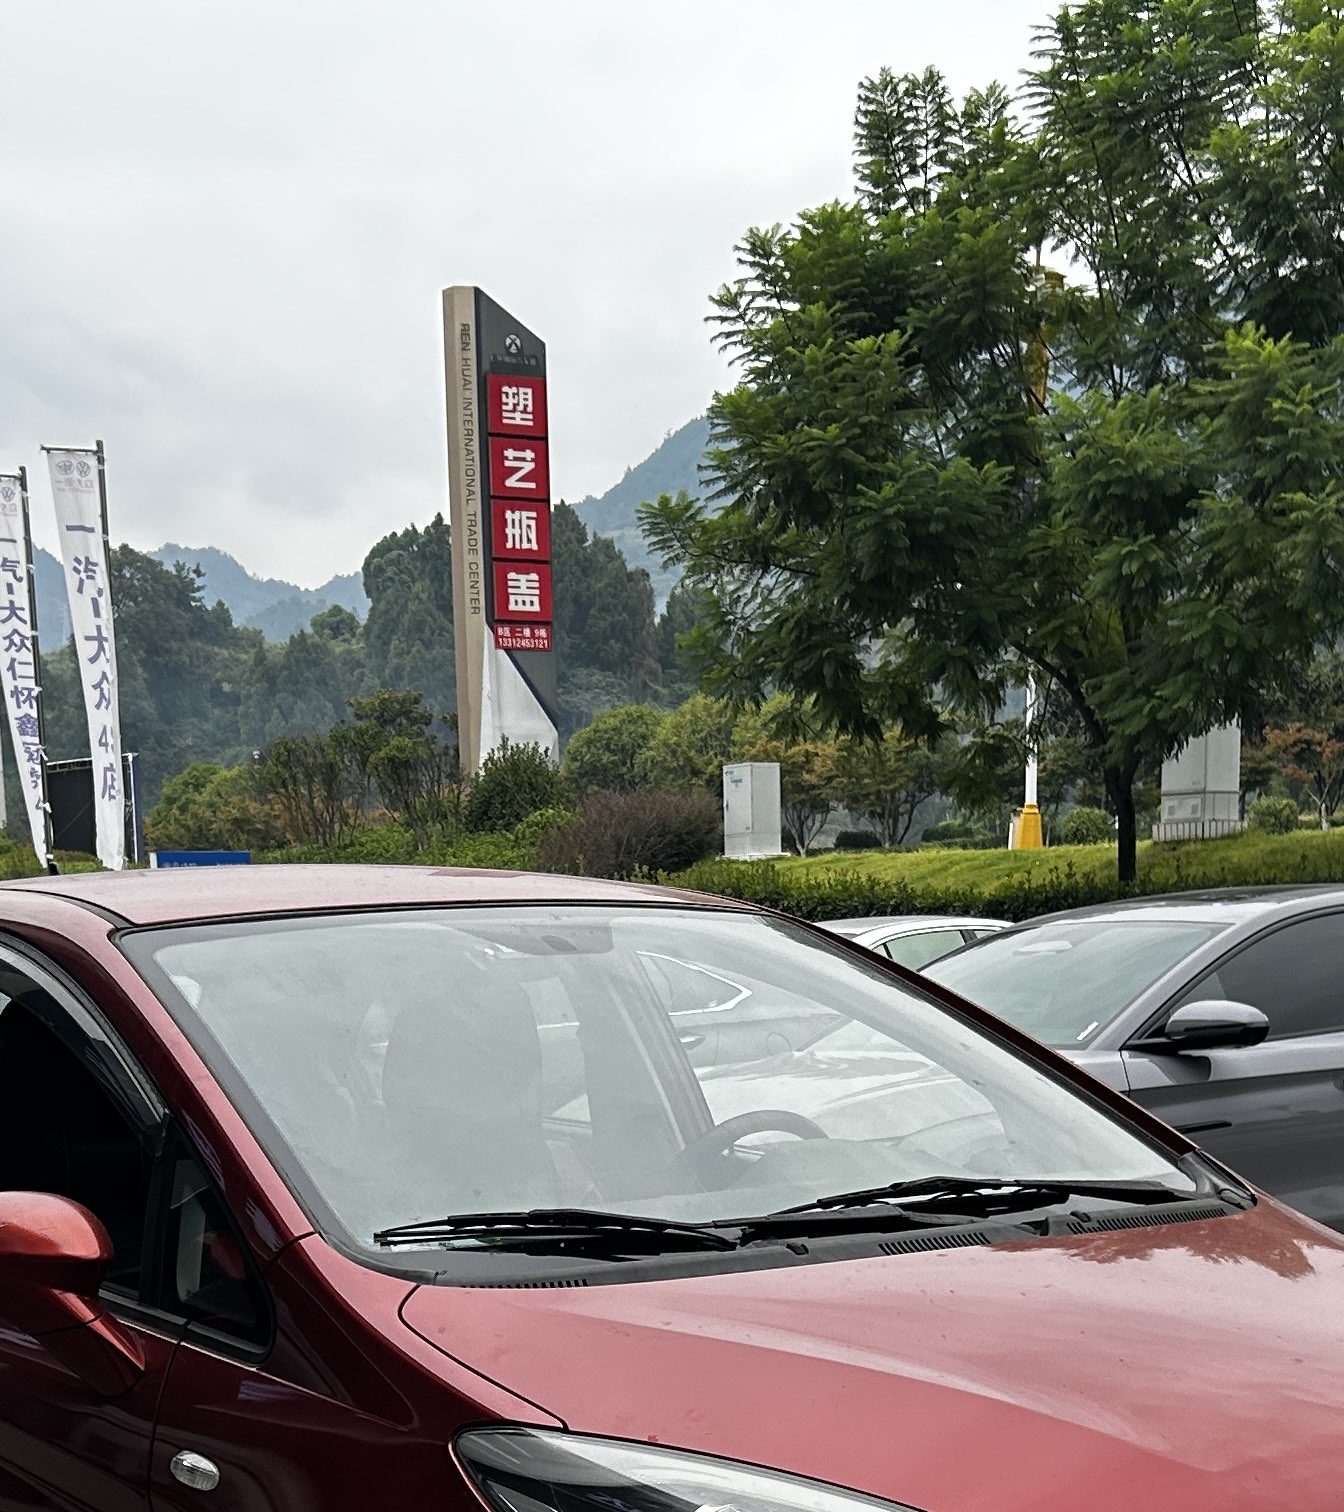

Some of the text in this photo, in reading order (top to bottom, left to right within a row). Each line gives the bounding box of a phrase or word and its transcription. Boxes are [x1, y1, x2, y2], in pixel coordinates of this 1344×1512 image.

[460, 322, 481, 616] REN HUAI INTERNATIONAL TRADE CENTER
